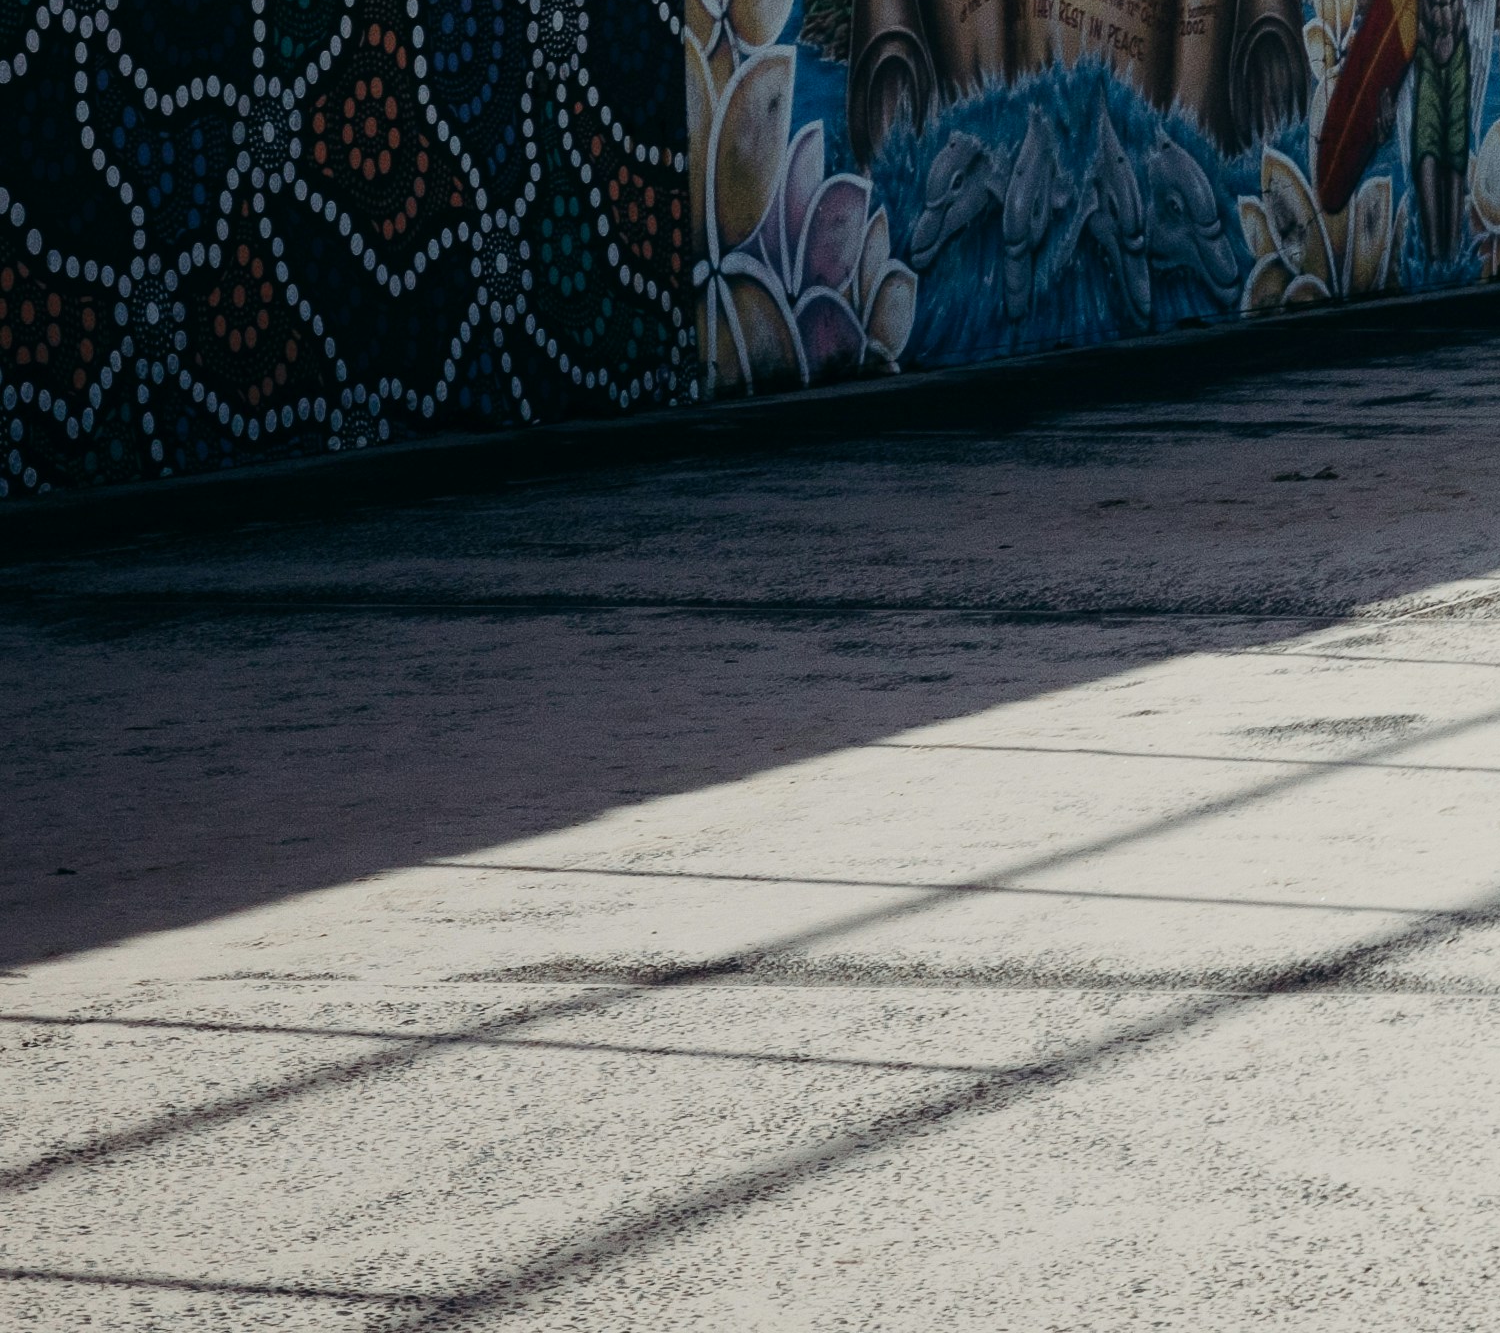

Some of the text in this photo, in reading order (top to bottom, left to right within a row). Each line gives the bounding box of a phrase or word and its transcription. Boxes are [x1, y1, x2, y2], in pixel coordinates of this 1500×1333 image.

[1059, 0, 1086, 30] REST
[1089, 15, 1103, 40] IN
[1108, 23, 1146, 63] PEACE
